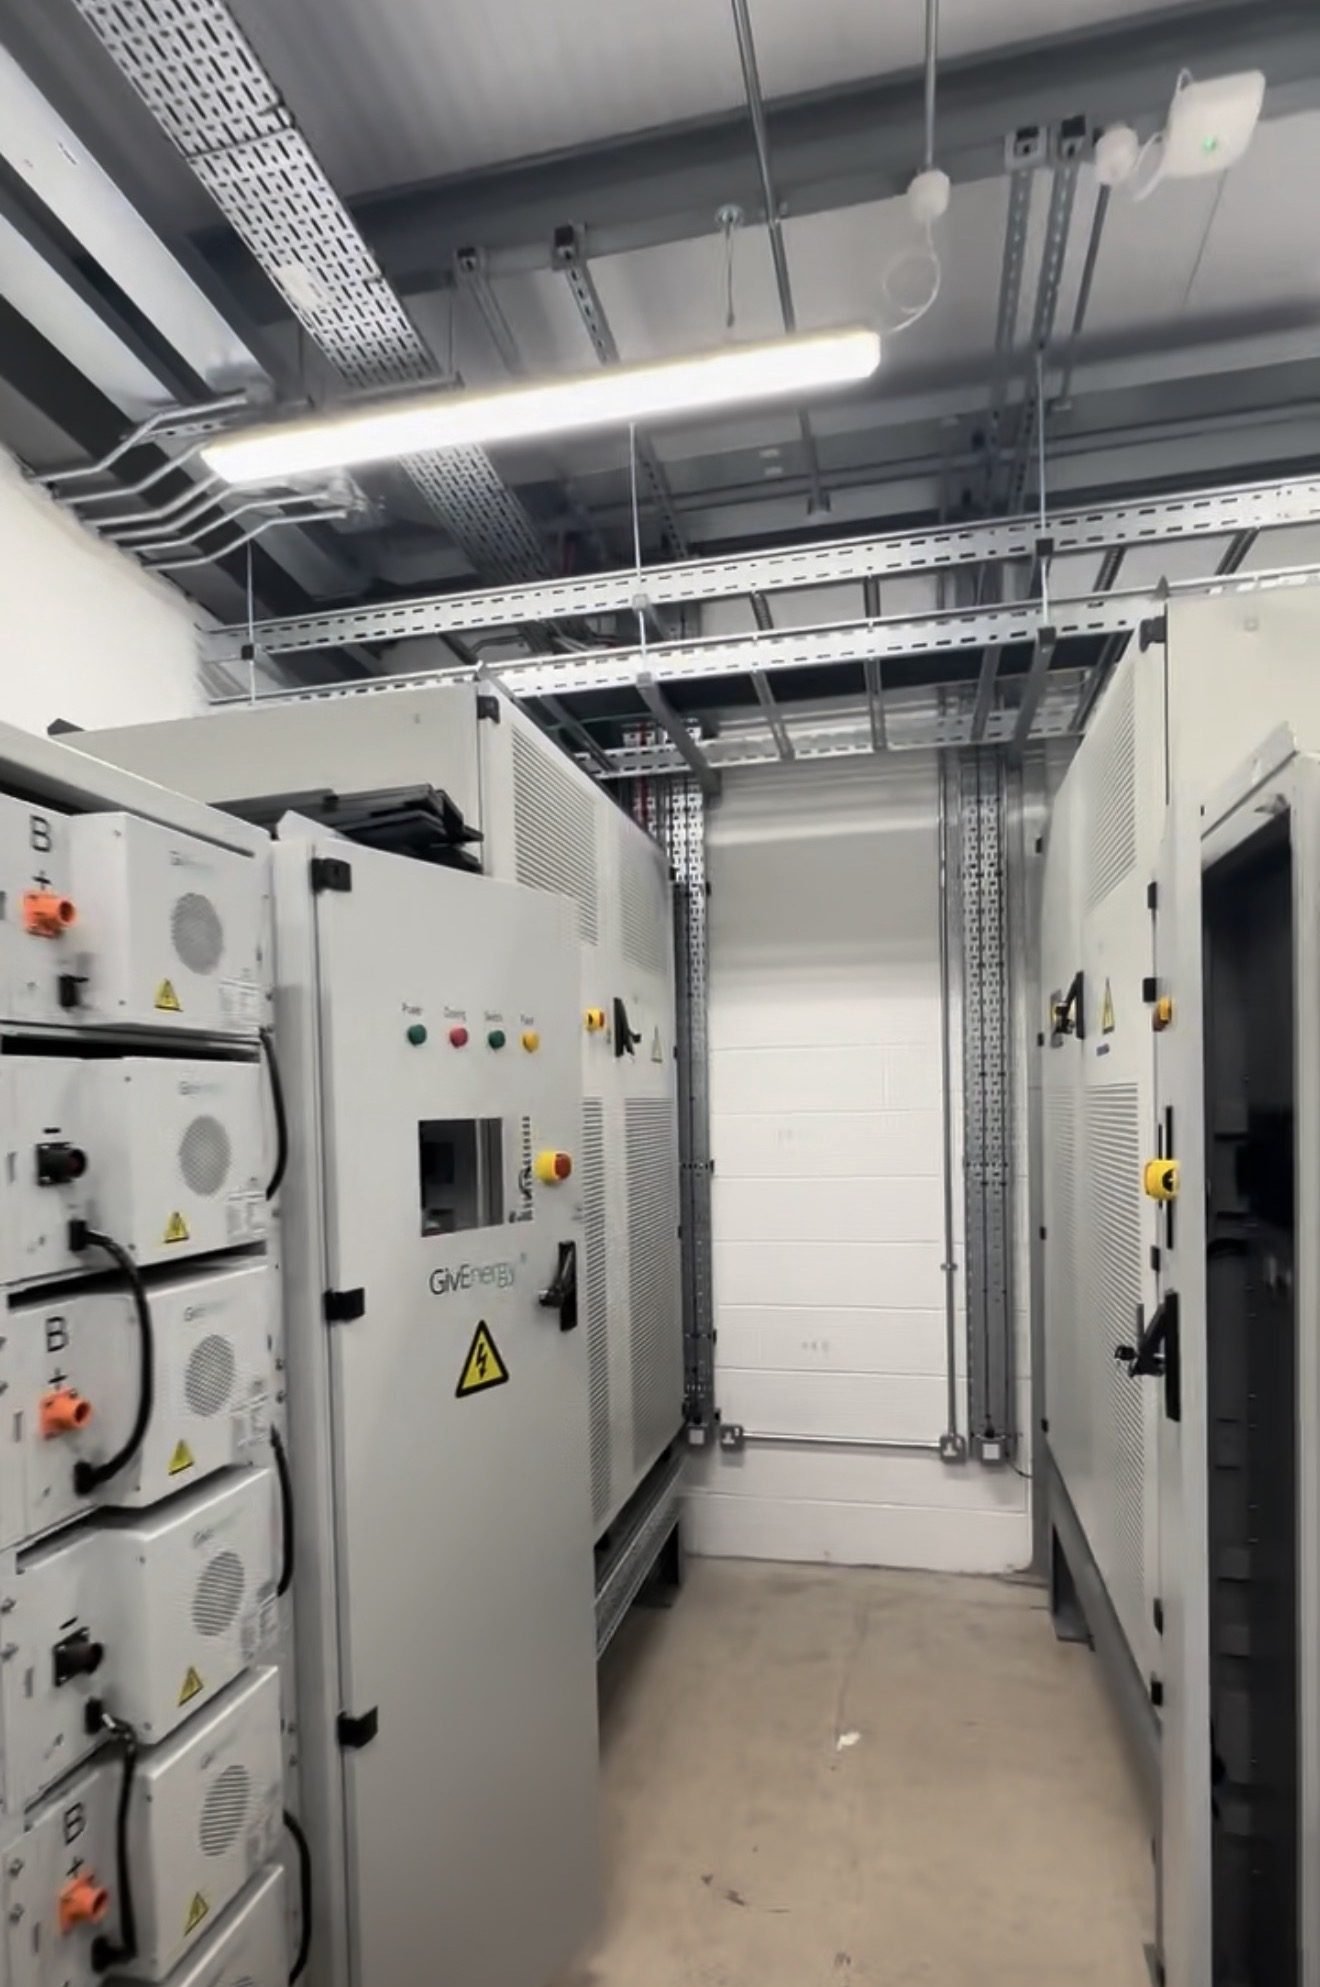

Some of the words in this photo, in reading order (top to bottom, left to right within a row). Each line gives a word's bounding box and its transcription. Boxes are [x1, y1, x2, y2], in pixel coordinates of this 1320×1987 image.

[30, 815, 52, 852] B
[46, 1315, 70, 1353] B
[64, 1801, 87, 1846] B
